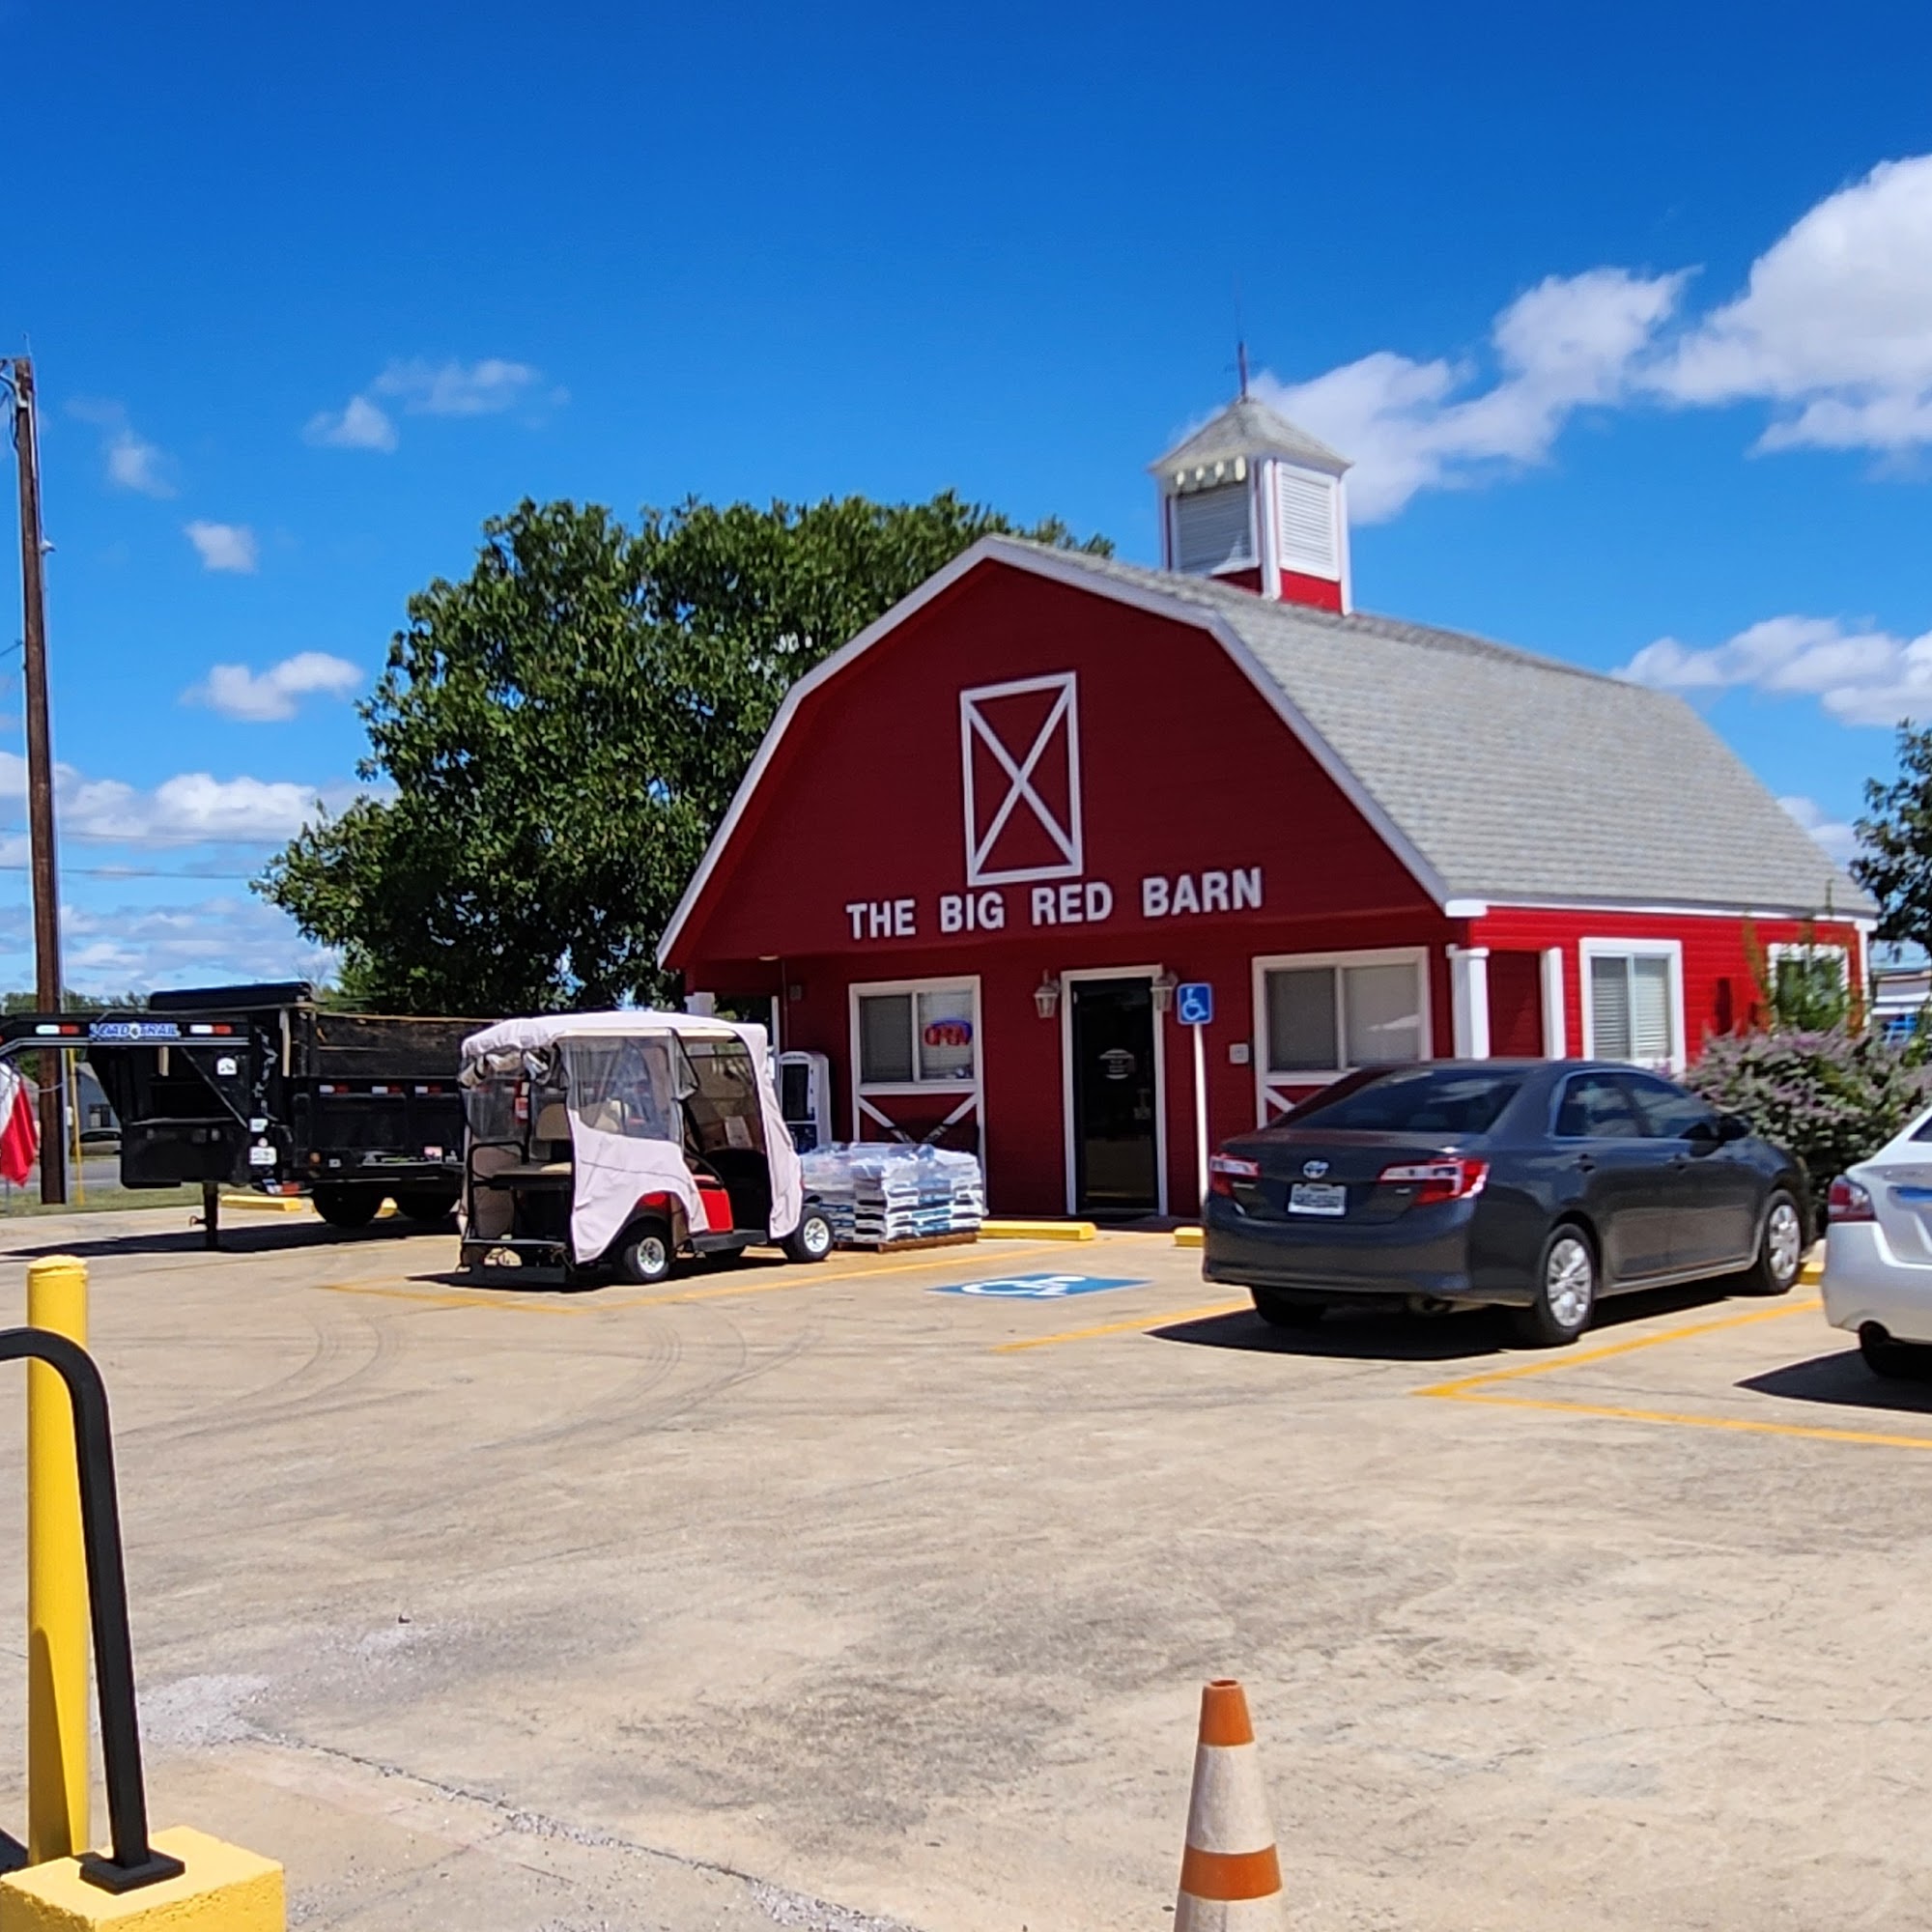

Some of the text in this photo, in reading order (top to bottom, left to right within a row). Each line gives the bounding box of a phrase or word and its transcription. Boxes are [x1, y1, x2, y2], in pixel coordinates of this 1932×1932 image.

[846, 867, 1263, 939] THE BIG RED BARN
